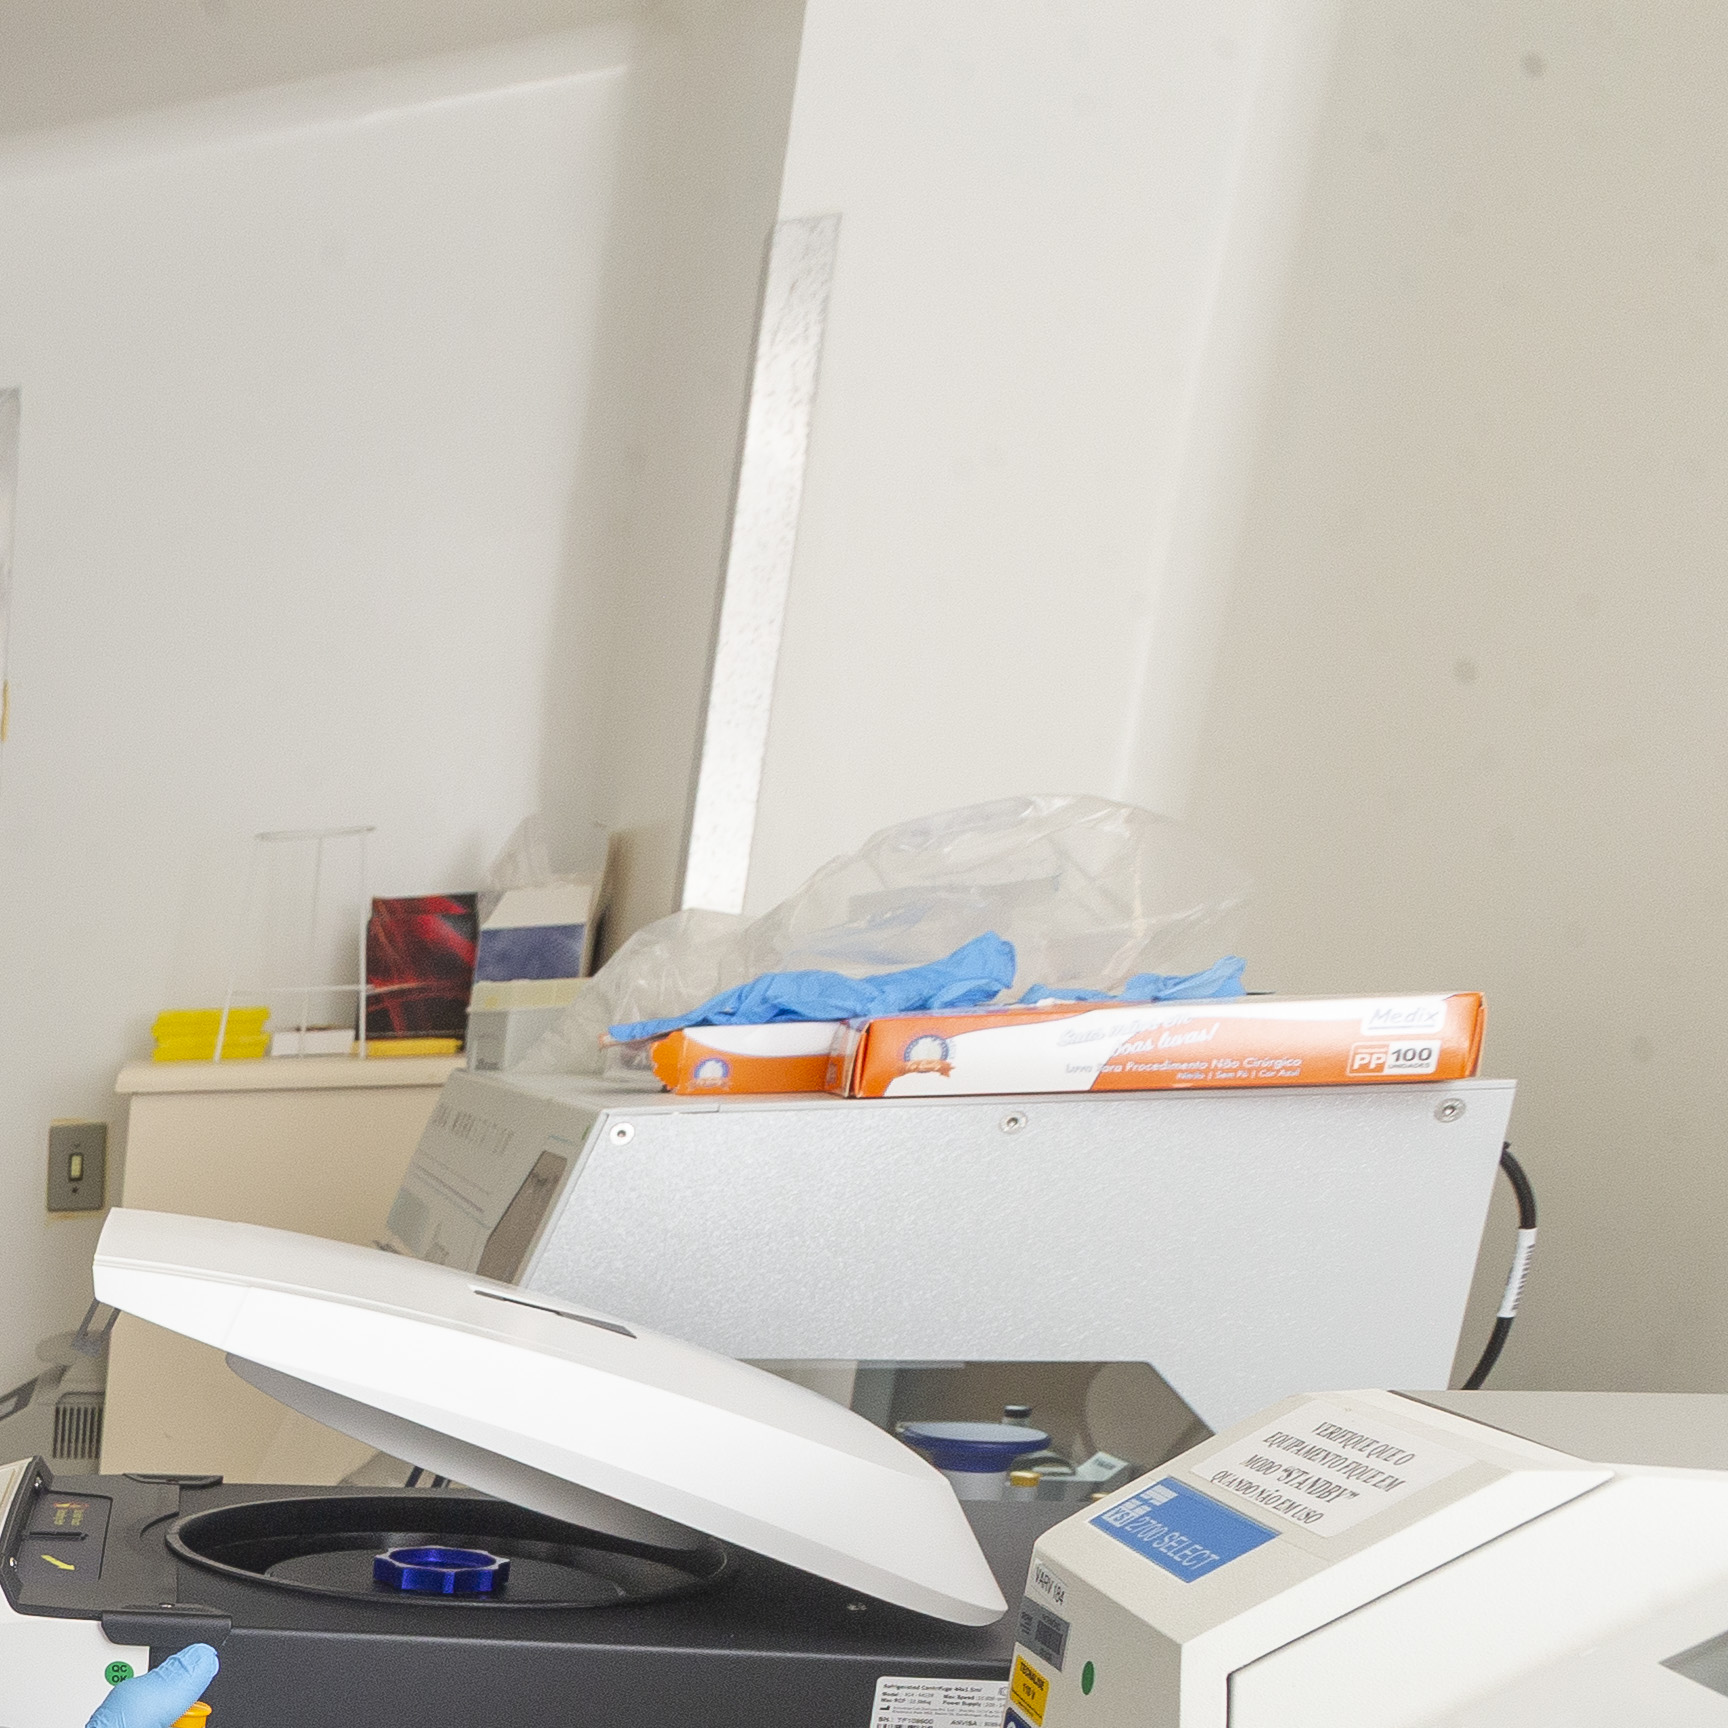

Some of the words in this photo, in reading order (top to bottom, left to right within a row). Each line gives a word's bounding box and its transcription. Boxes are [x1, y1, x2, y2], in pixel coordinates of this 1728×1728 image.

[1369, 1008, 1439, 1025] Medix
[1158, 1022, 1221, 1049] luvas!
[1126, 1059, 1209, 1073] Procedimento
[1211, 1057, 1239, 1069] Não
[1242, 1055, 1302, 1070] Cirúrgico
[1352, 1054, 1386, 1070] PP
[1392, 1047, 1432, 1063] 100
[1312, 1421, 1379, 1452] VERIFIQUE
[1368, 1444, 1403, 1463] QUE
[1400, 1453, 1416, 1466] O
[1240, 1454, 1283, 1475] MODO
[1262, 1431, 1350, 1469] EQUIPAMENTO
[1340, 1459, 1382, 1485] FIQUE
[1371, 1474, 1406, 1492] EM
[1209, 1470, 1262, 1497] QUANDO
[1251, 1487, 1283, 1509] NÃO
[1274, 1497, 1303, 1518] EM
[1293, 1506, 1324, 1525] USO
[1105, 1507, 1134, 1527] YSI
[1125, 1517, 1164, 1542] 2700
[1152, 1531, 1221, 1570] SELECT
[112, 1664, 127, 1673] QC
[112, 1674, 127, 1683] OK
[921, 1684, 952, 1692] Centrifuge
